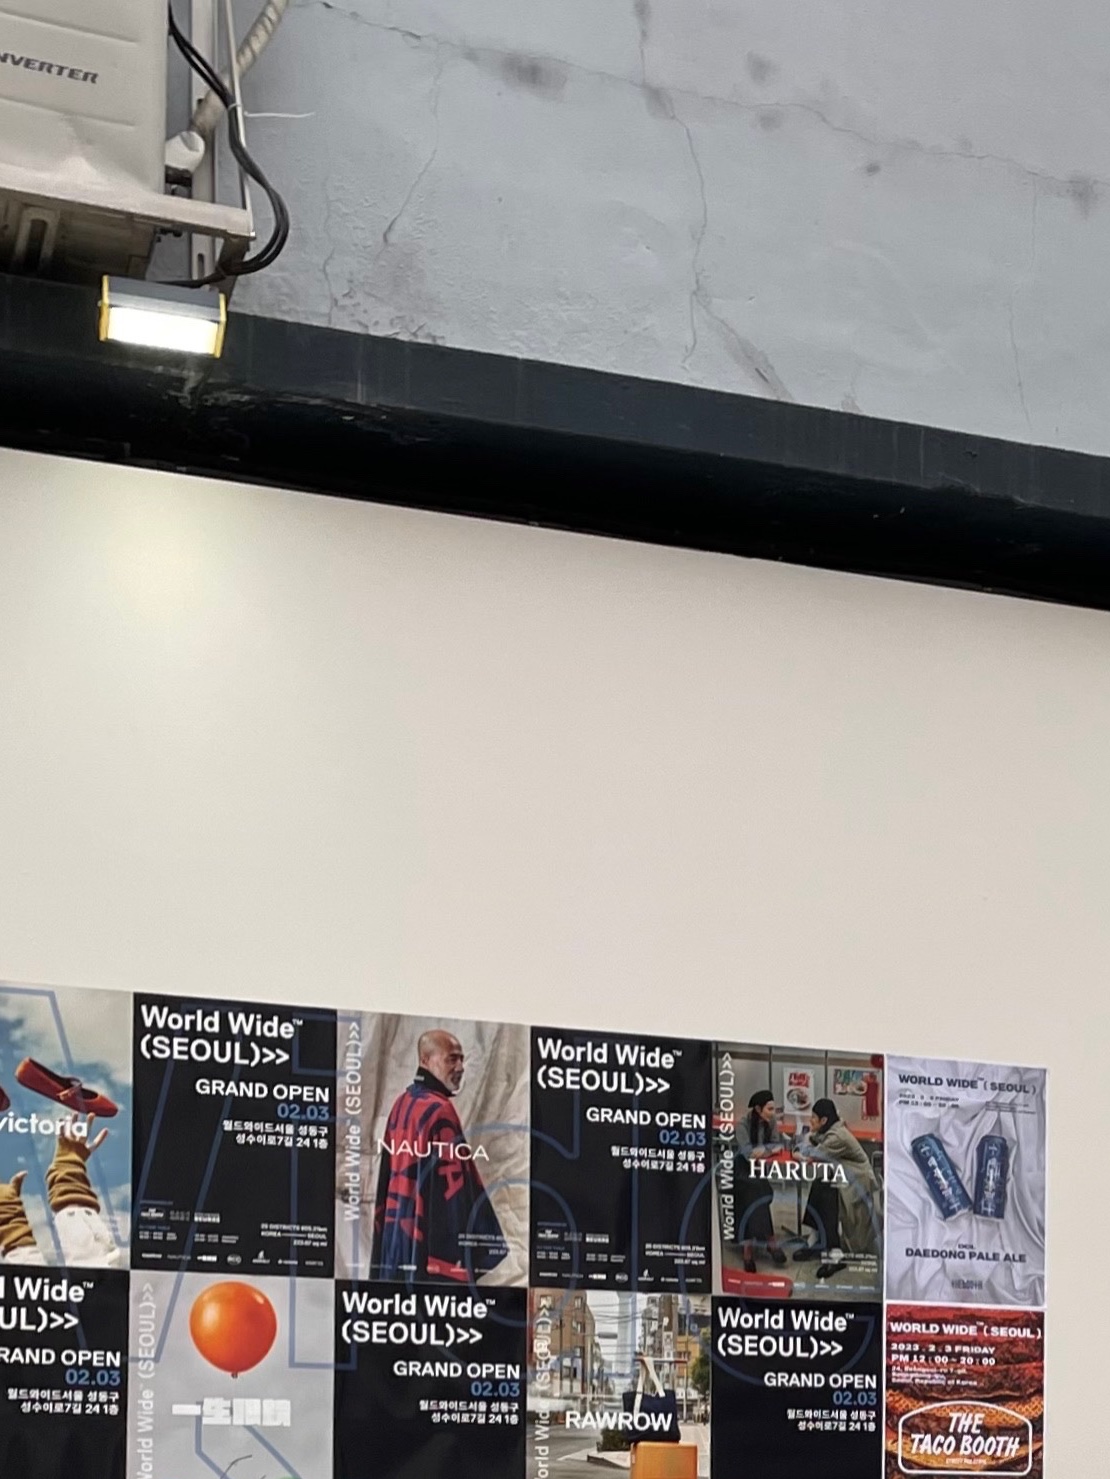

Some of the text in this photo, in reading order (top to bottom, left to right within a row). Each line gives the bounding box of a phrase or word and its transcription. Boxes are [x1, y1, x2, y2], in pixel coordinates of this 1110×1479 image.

[0, 53, 98, 84] NVERTER
[141, 1004, 219, 1033] World
[538, 1037, 607, 1063] World
[898, 1074, 944, 1087] WORLD
[195, 1078, 330, 1103] GRAND OPEN
[277, 1103, 330, 1121] 02.03
[586, 1106, 706, 1130] GRAND OPEN
[296, 1138, 311, 1148] 24
[660, 1130, 706, 1147] 02.03
[377, 1139, 490, 1162] NAUTICA
[676, 1162, 689, 1173] 24
[748, 1158, 849, 1183] HARUTA
[344, 1173, 361, 1221] World
[722, 1195, 735, 1240] World
[905, 1248, 1027, 1263] DAEDONG PALE ALE
[343, 1291, 417, 1316] World
[718, 1307, 784, 1330] World
[889, 1321, 940, 1334] WORLD
[891, 1343, 919, 1352] 2023
[955, 1346, 996, 1355] FRIDAY
[61, 1350, 121, 1367] OPEN
[891, 1354, 910, 1363] PM
[981, 1357, 996, 1366] 00
[65, 1369, 121, 1386] 02.03
[393, 1361, 520, 1380] GRAND OPEN
[471, 1382, 520, 1397] 02.03
[764, 1372, 877, 1389] GRAND OPEN
[833, 1391, 877, 1406] 02.03
[85, 1403, 100, 1414] 24
[488, 1414, 502, 1424] 24
[535, 1398, 549, 1441] Wid
[565, 1410, 673, 1432] RAWROW
[849, 1422, 861, 1432] 24
[948, 1412, 986, 1434] THE
[910, 1434, 1020, 1457] TACO BOOTH
